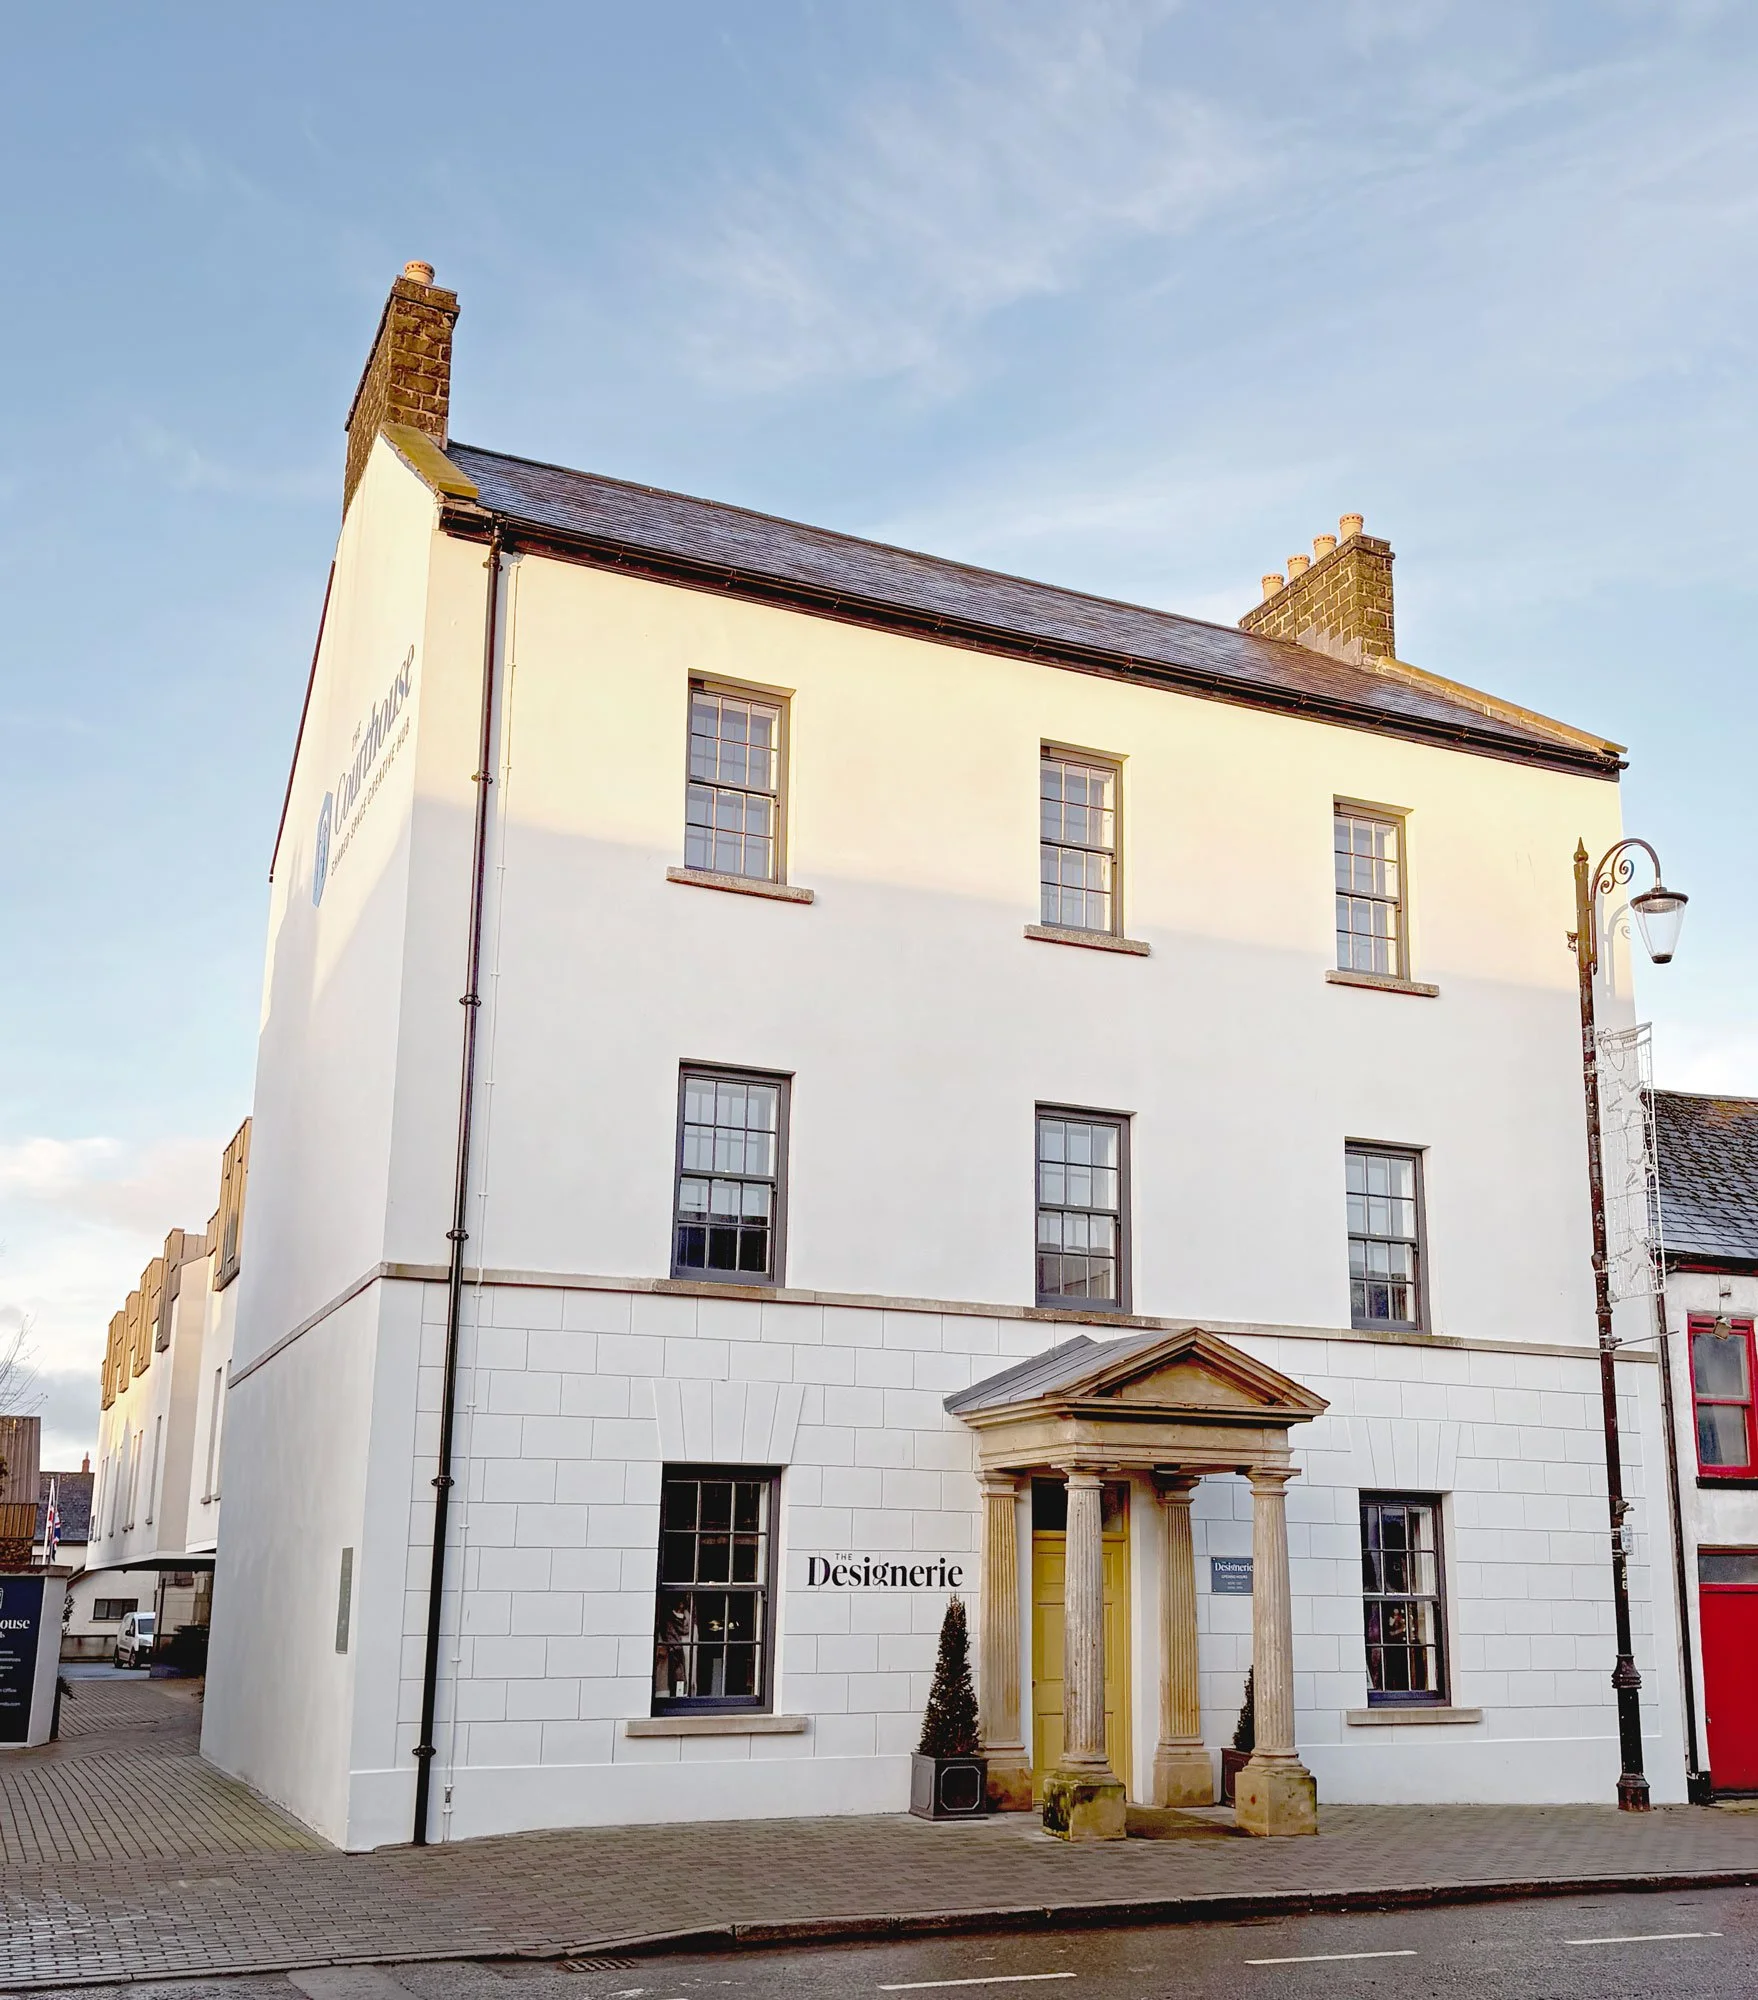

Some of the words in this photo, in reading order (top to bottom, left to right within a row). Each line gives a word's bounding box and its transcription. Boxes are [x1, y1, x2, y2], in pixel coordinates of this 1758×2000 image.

[334, 643, 415, 836] Courthouse
[351, 720, 362, 752] THE
[330, 832, 350, 876] SHARED
[350, 796, 367, 839] SPACE
[367, 742, 396, 805] CREATIVE
[396, 715, 410, 753] HUB
[807, 1556, 964, 1588] Designerie
[0, 1619, 31, 1630] ouse
